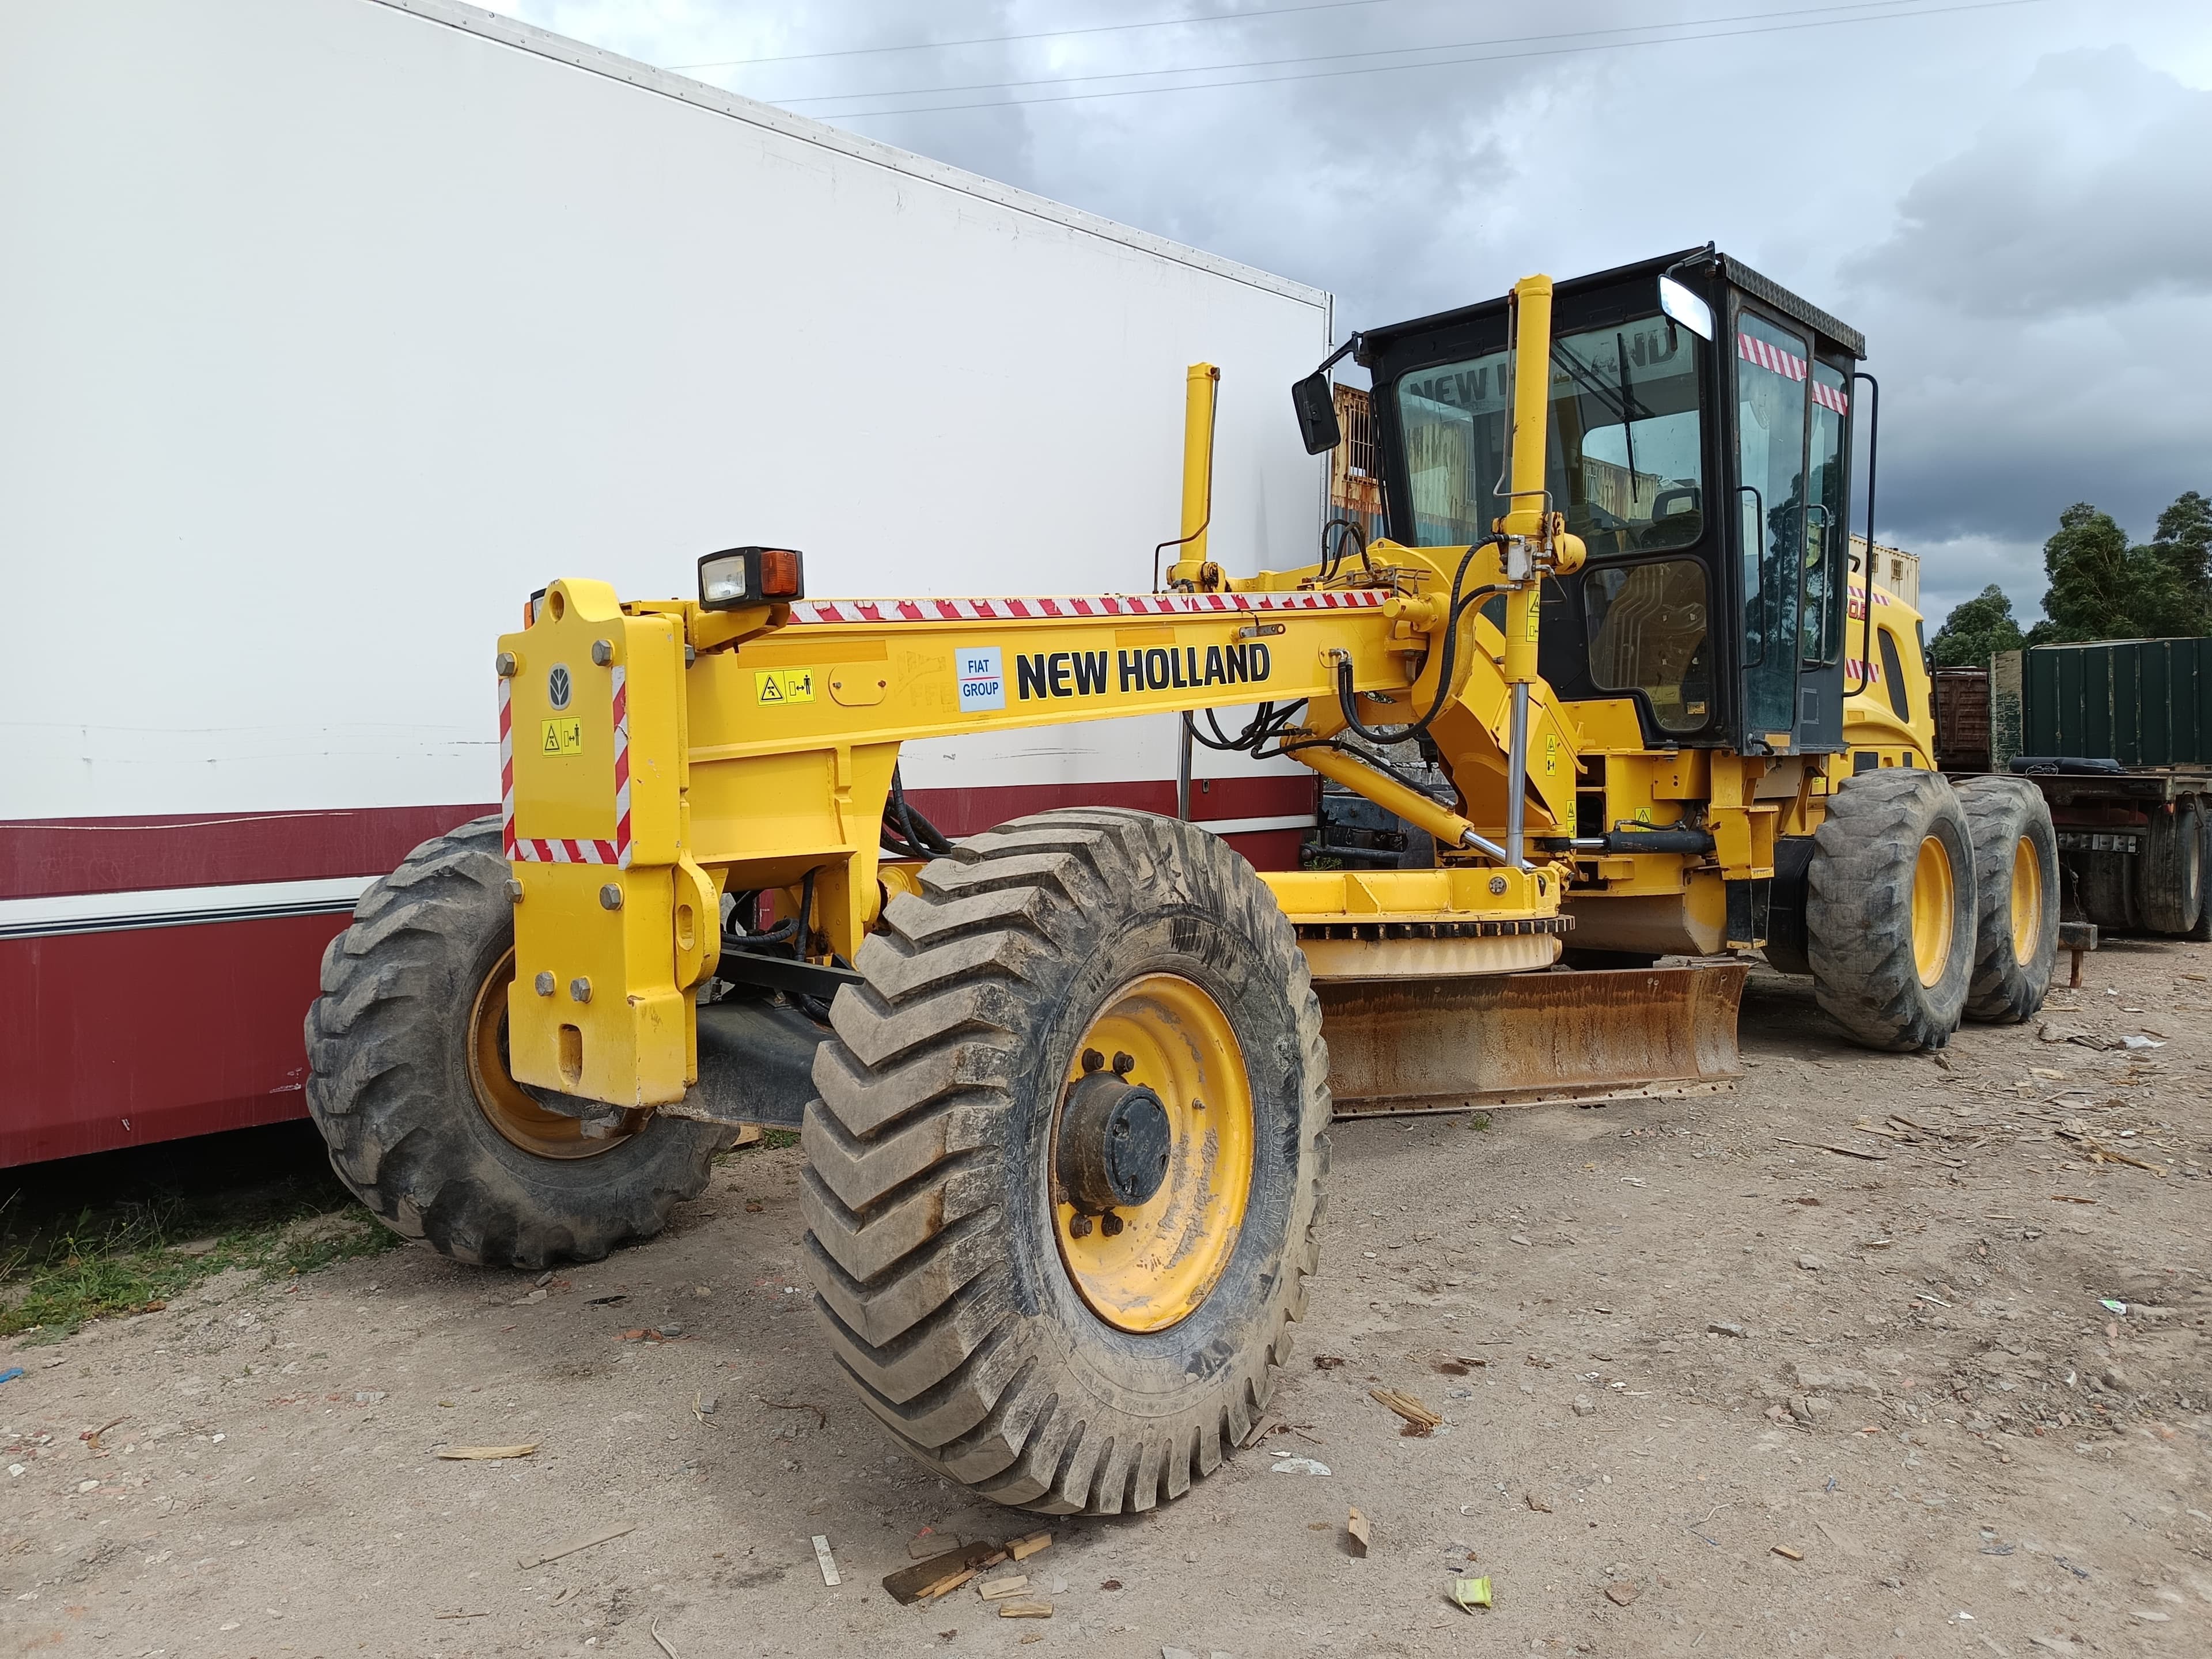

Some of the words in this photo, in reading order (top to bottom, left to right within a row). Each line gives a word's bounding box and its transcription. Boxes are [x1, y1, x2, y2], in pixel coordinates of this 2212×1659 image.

[1410, 367, 1488, 406] NEW
[968, 659, 990, 673] FIAT
[1016, 650, 1109, 700] NEW
[1117, 642, 1271, 692] HOLLAND
[963, 681, 999, 697] GROUP
